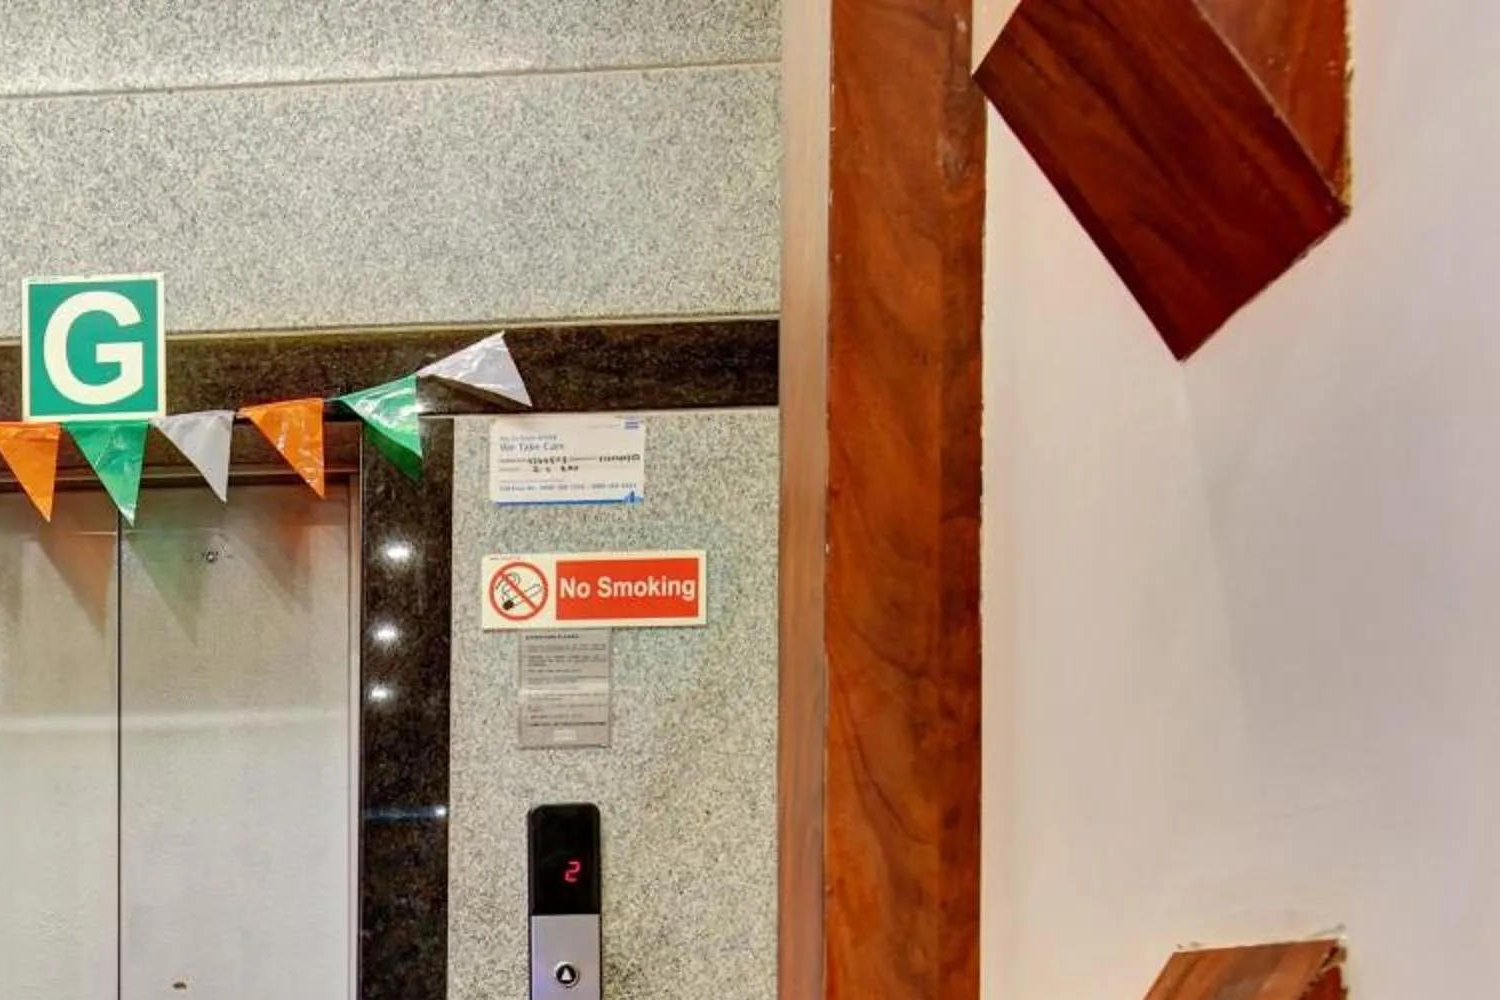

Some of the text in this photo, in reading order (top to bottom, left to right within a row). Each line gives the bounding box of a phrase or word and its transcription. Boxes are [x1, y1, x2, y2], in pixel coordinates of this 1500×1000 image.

[43, 290, 143, 406] G
[560, 575, 696, 602] No Smoking
[565, 861, 581, 883] 2
